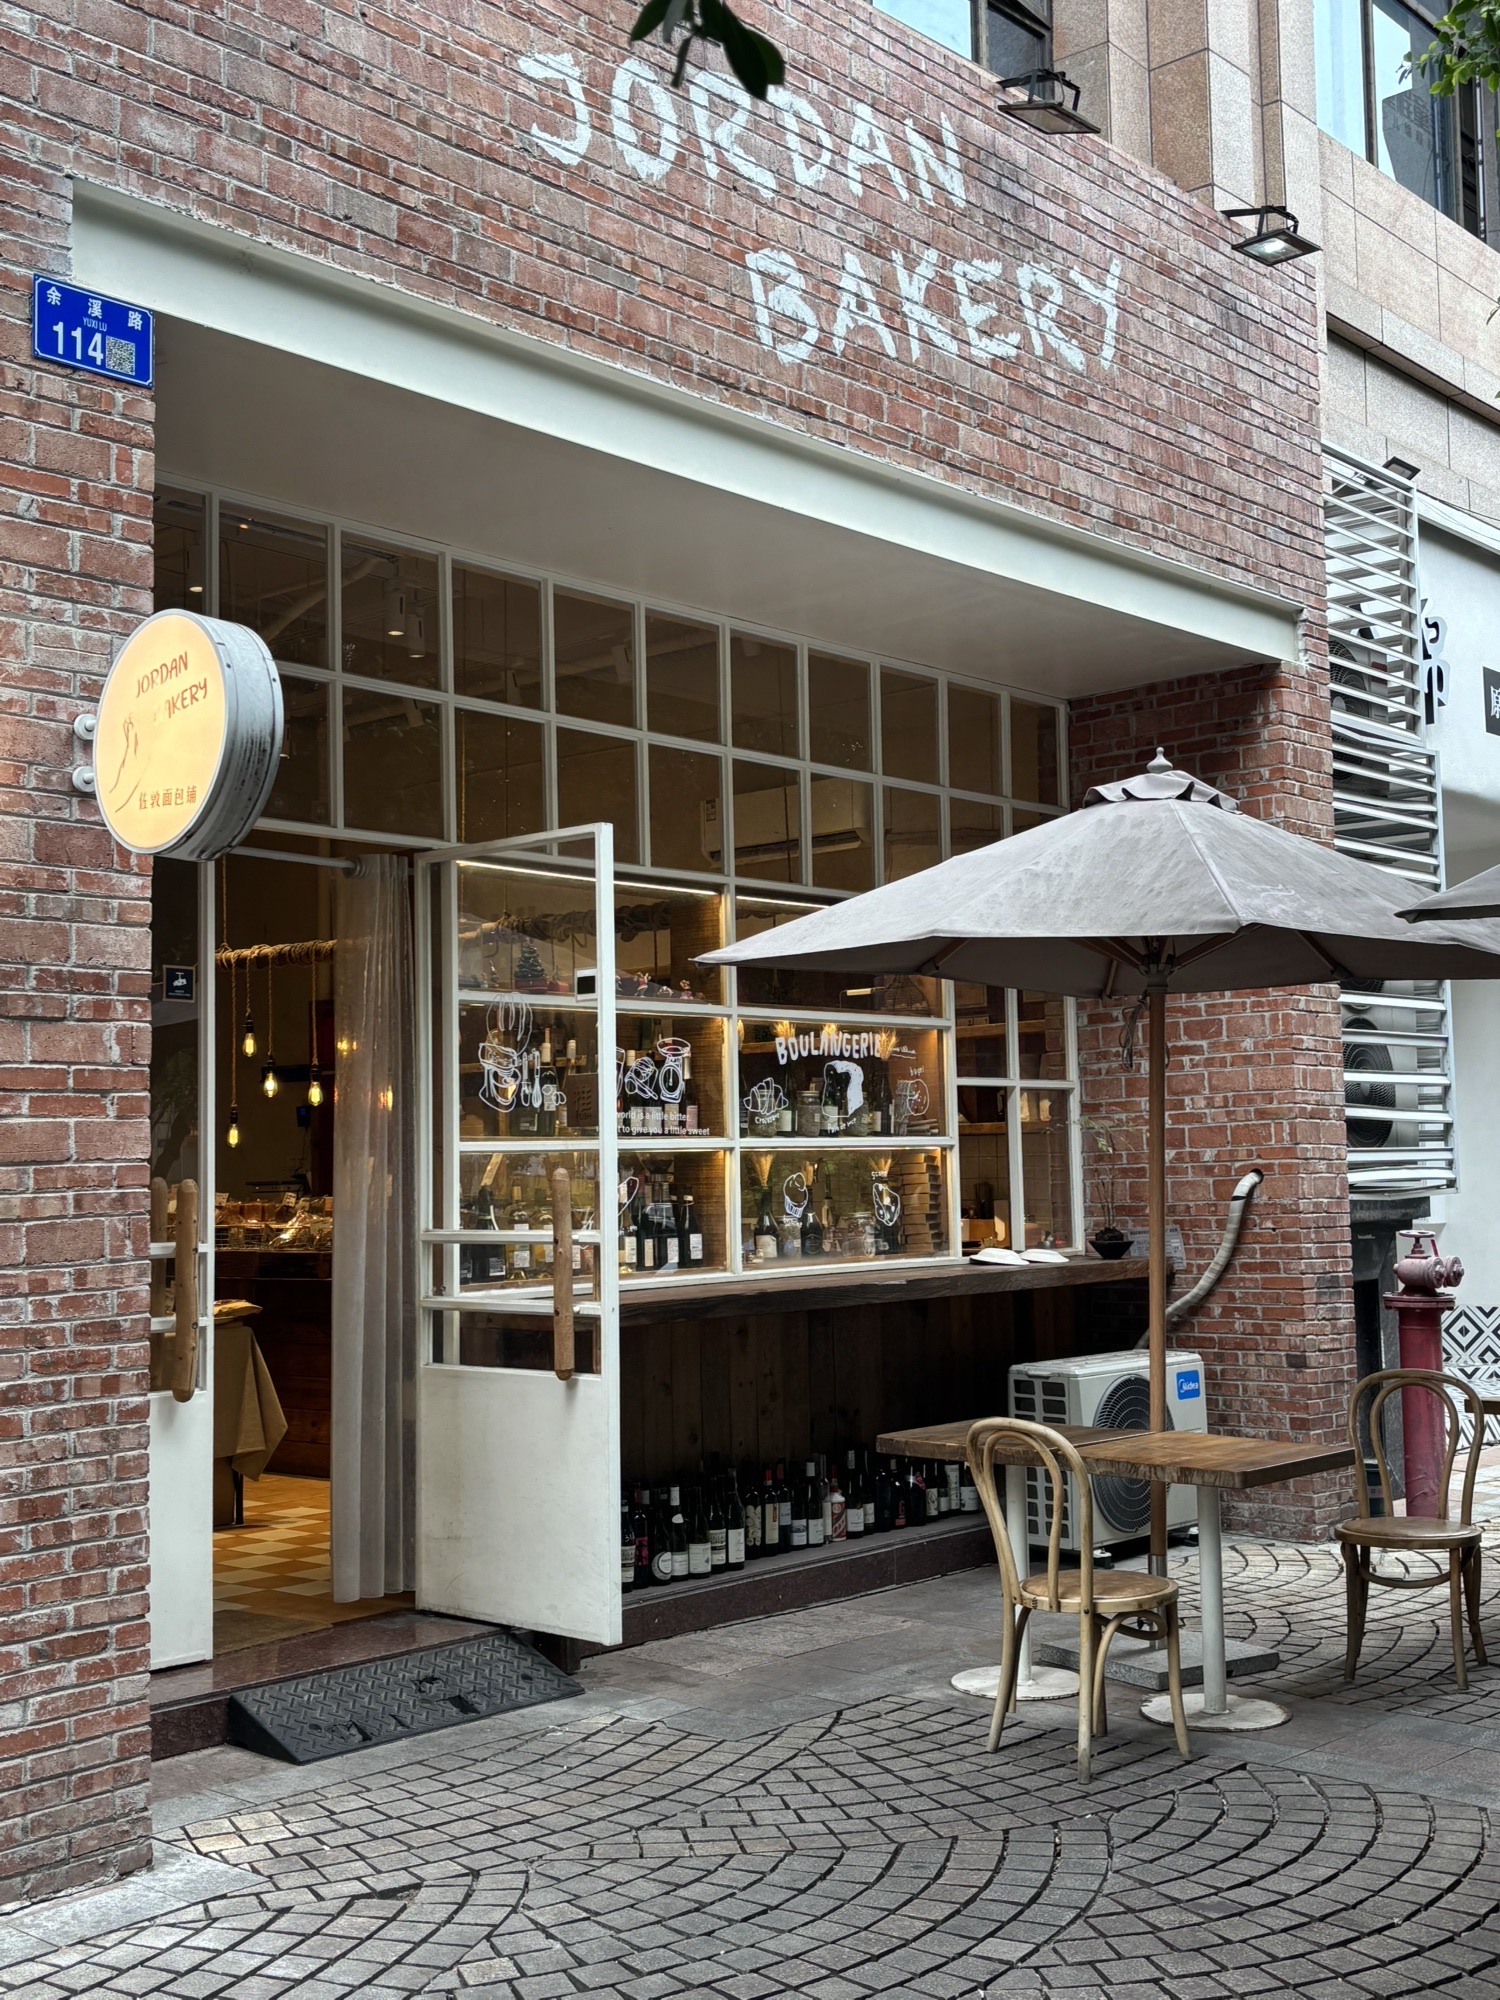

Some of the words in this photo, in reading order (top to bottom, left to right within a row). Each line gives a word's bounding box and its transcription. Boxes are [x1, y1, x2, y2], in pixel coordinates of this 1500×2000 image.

[517, 51, 967, 208] JORDAN
[46, 286, 143, 332] 余溪路
[82, 316, 98, 329] YUXI
[98, 321, 108, 332] LU
[745, 247, 1122, 373] BAKERY
[52, 321, 104, 366] 114
[136, 651, 189, 699] JORDAN
[154, 677, 208, 722] AKERY
[775, 1031, 882, 1065] BOULANGERIE
[622, 1126, 630, 1134] to
[632, 1126, 649, 1136] give
[649, 1127, 663, 1138] you
[670, 1126, 687, 1136] little
[688, 1128, 710, 1136] sweet
[636, 1111, 644, 1120] is
[645, 1112, 650, 1120] a
[651, 1111, 669, 1121] little
[1178, 1378, 1199, 1393] Midea
